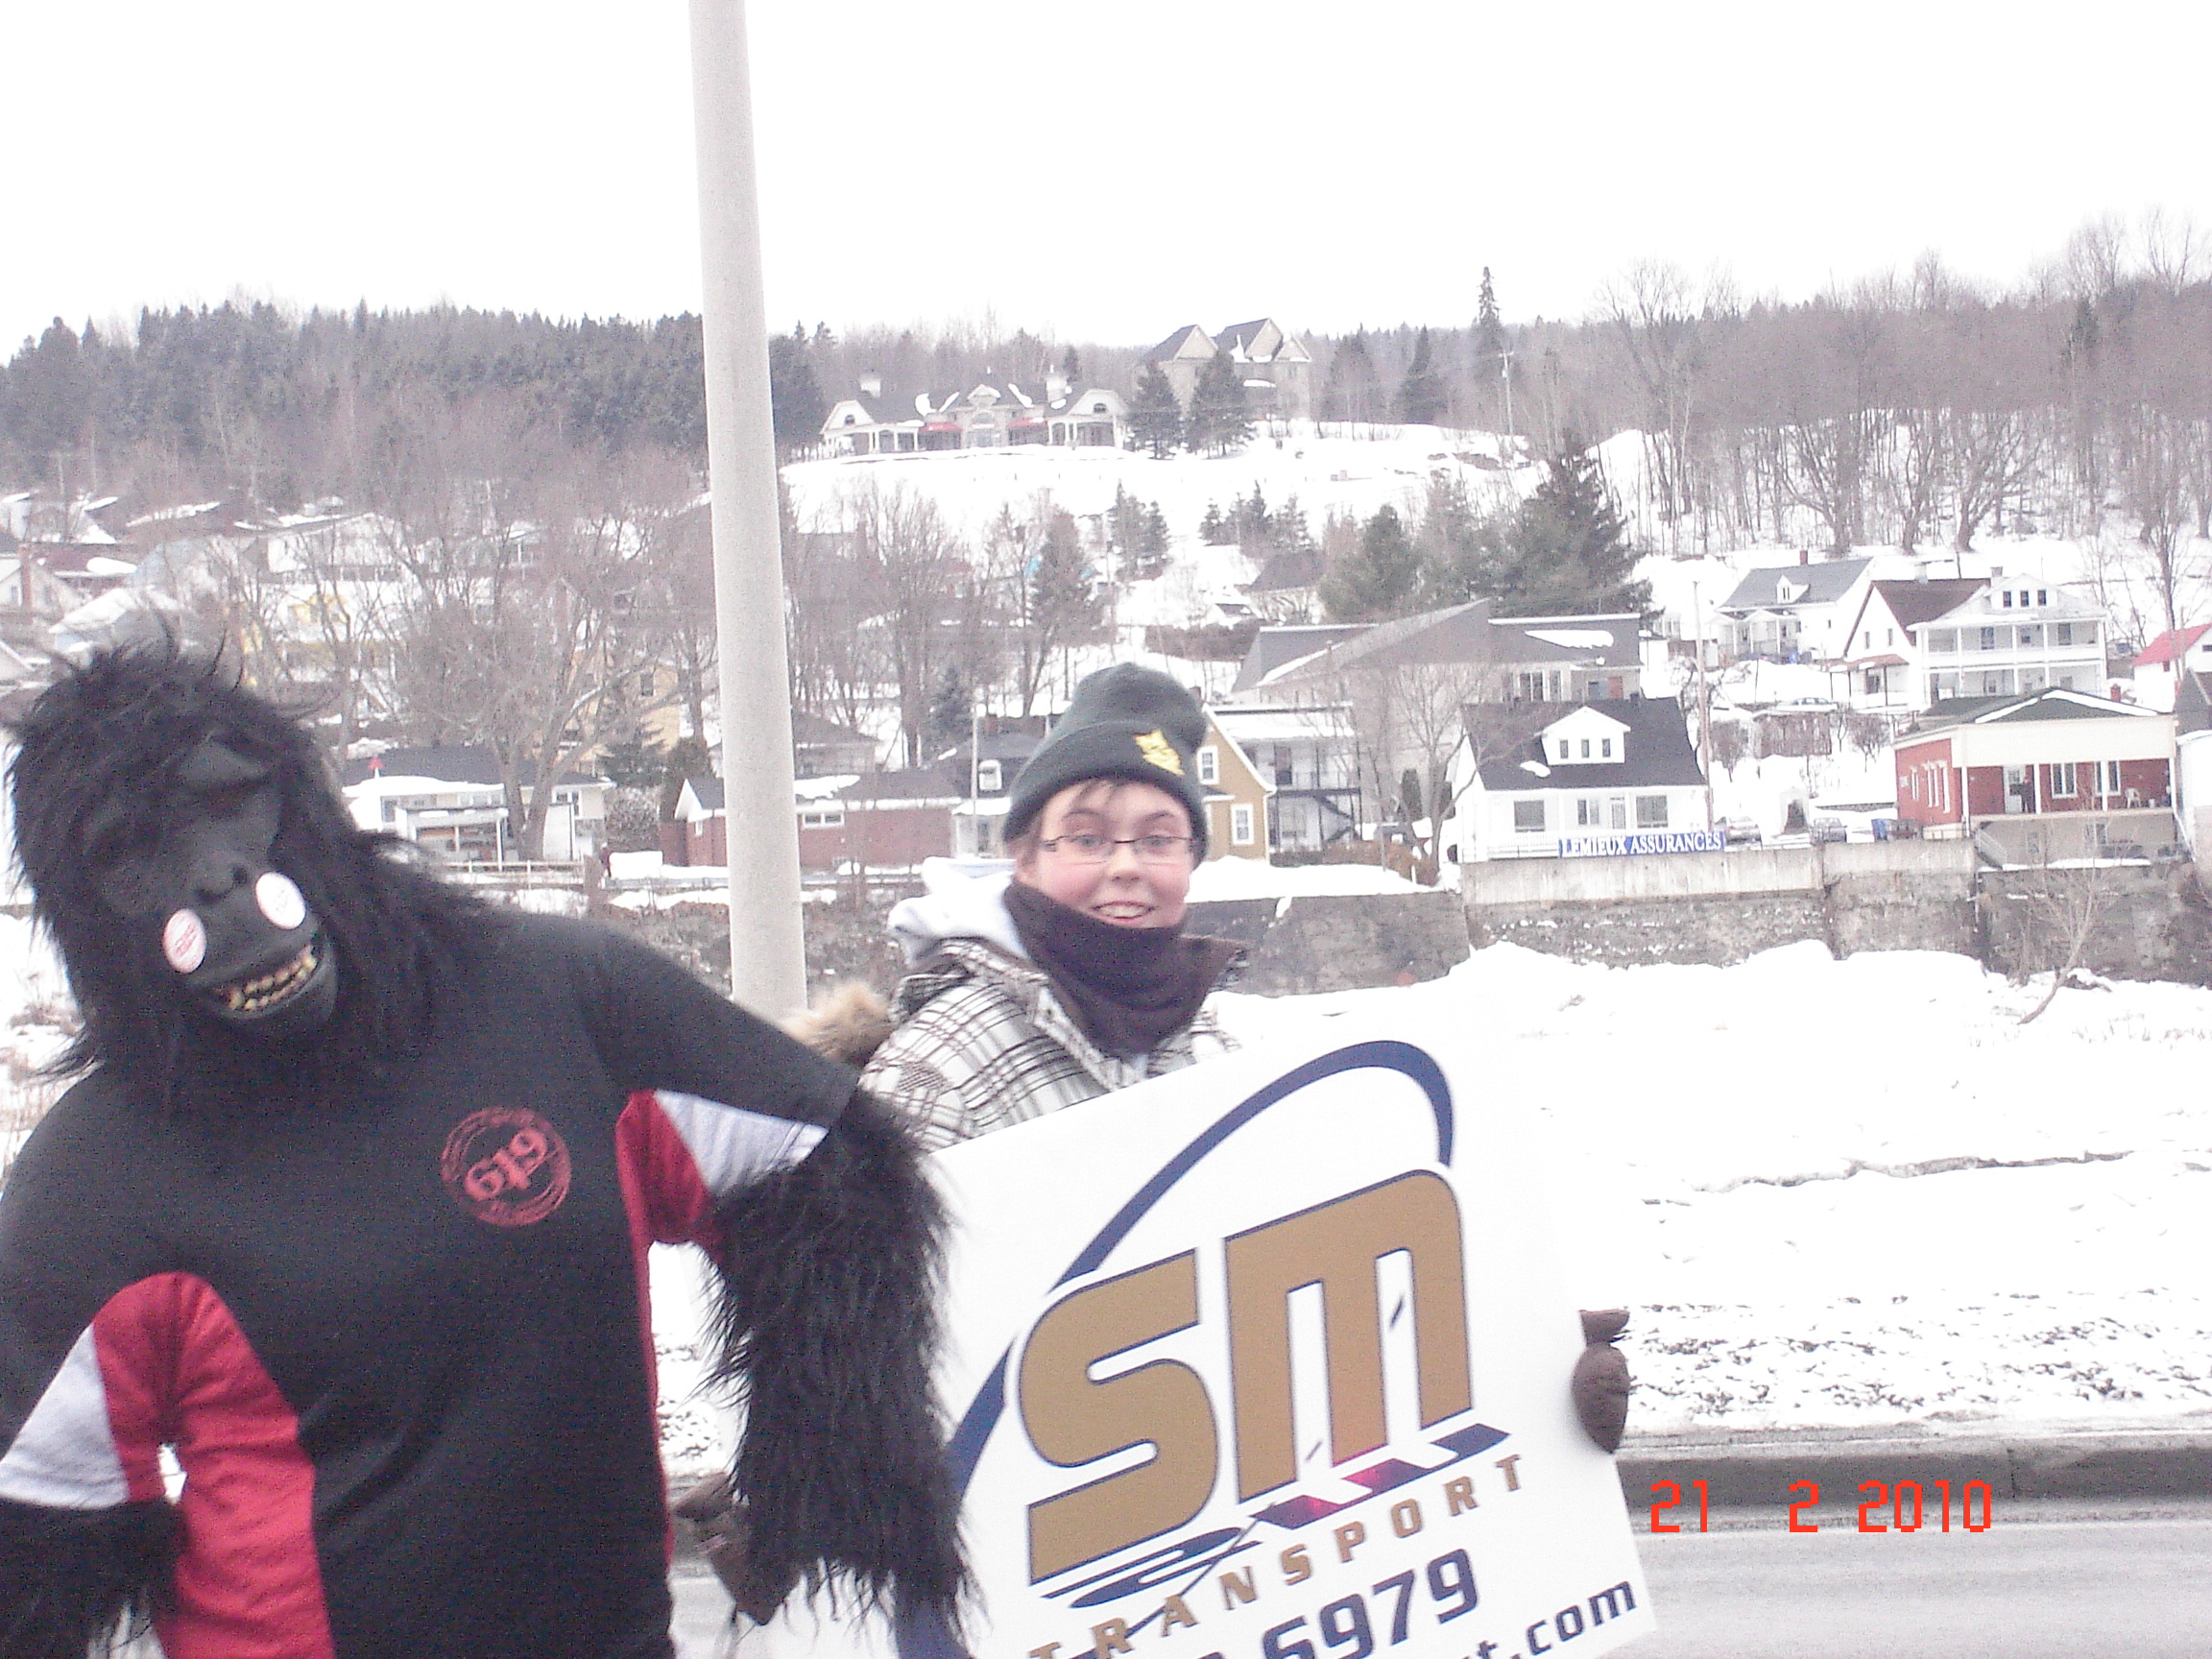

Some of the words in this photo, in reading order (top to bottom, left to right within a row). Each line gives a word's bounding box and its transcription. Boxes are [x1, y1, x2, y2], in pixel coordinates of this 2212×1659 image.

[1561, 836, 1627, 857] LEMIEUX
[1629, 831, 1722, 854] ASSURANCES
[464, 1127, 549, 1200] 619
[1018, 1168, 1473, 1587] SM
[1028, 1454, 1523, 1659] TRANSPORT
[1262, 1548, 1479, 1659] 6979
[1461, 1581, 1637, 1659] t.com
